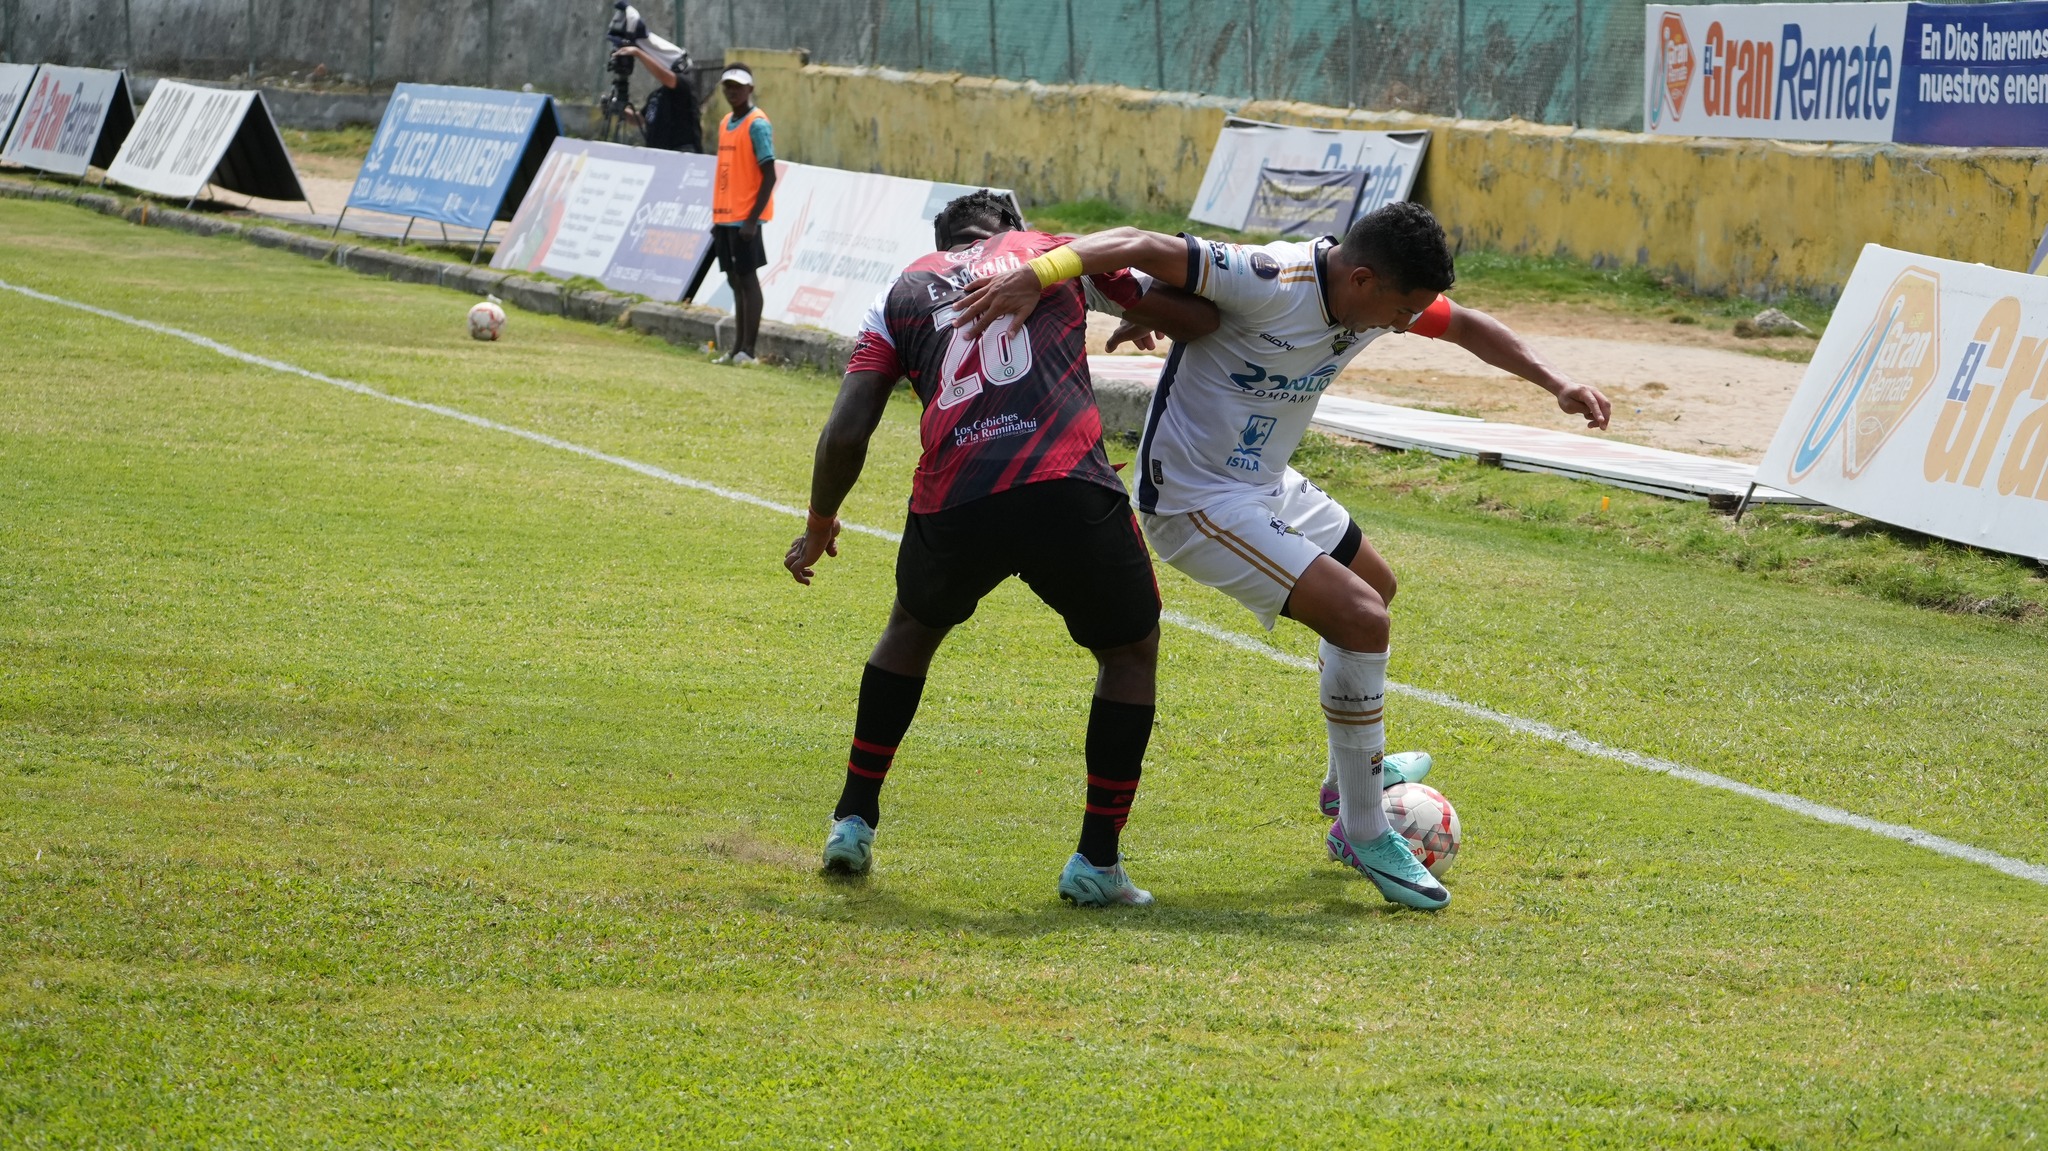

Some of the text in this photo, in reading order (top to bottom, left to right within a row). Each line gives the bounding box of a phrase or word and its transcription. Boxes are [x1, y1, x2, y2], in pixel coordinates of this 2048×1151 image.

[1921, 22, 2048, 61] En Dios haremos
[1704, 21, 1892, 121] Gran Remate
[1919, 67, 1999, 104] nuestros
[32, 80, 72, 151] Gran
[57, 82, 104, 157] Remate
[404, 98, 446, 123] INSTITUTO
[439, 100, 482, 128] SUPERIOR
[793, 249, 895, 286] INNOVA EDUCATIVA
[1878, 321, 1932, 369] Gran
[1242, 389, 1315, 403] OMPANY
[1863, 368, 1913, 402] Remate
[954, 413, 1018, 437] Los Cebiches
[956, 436, 968, 447] de
[970, 431, 979, 441] la
[981, 418, 1037, 438] Rumiñahui
[1226, 456, 1259, 471] ISTLA
